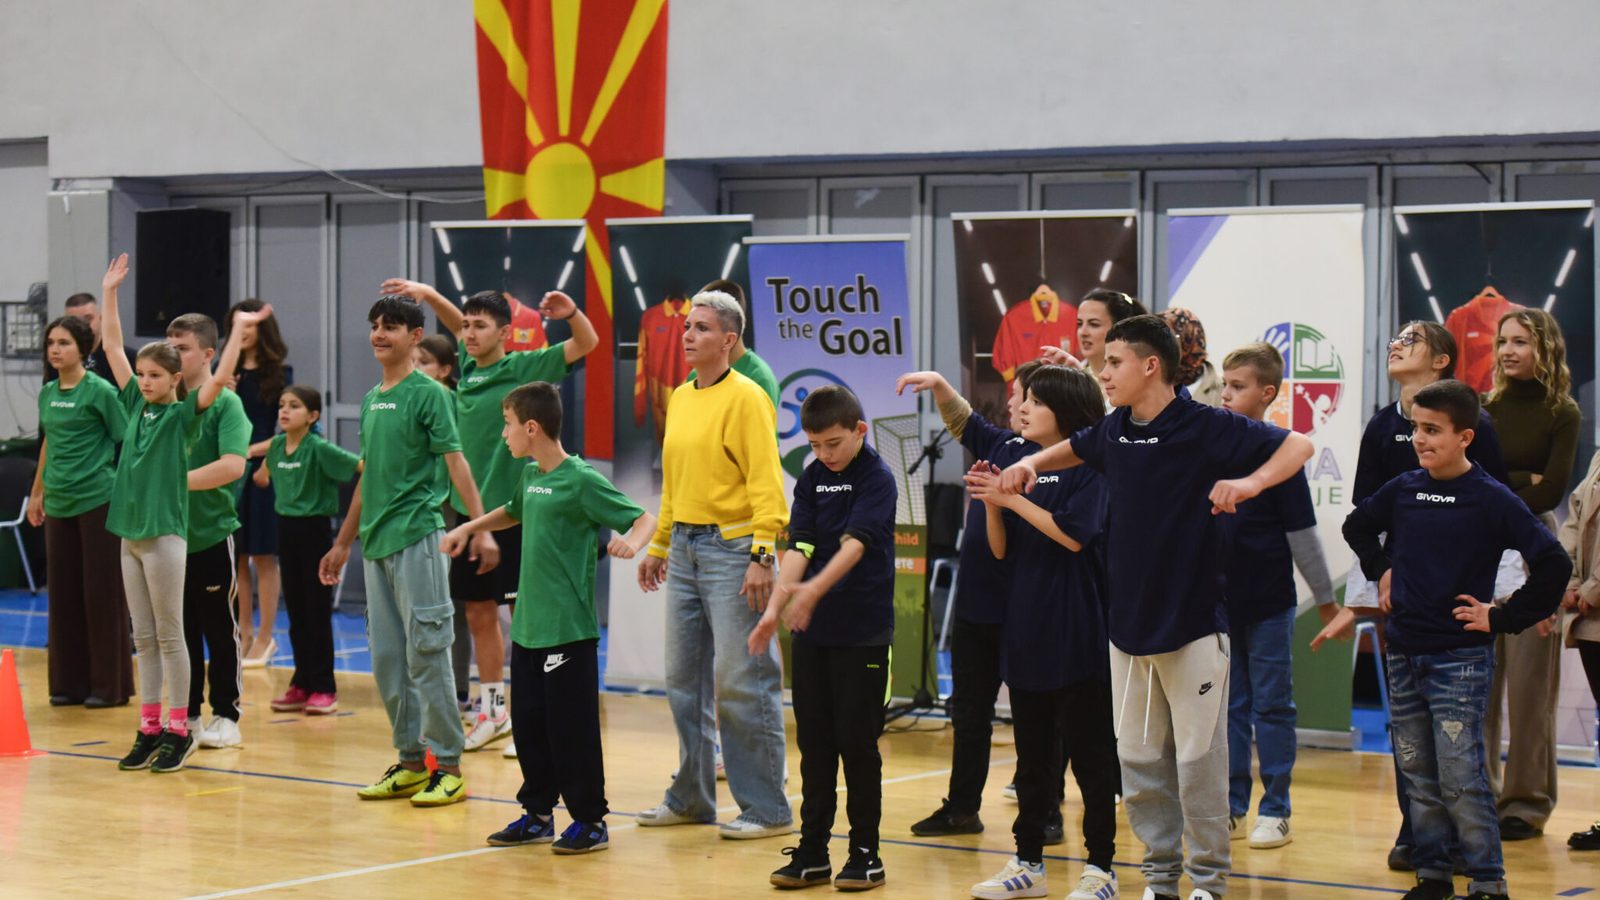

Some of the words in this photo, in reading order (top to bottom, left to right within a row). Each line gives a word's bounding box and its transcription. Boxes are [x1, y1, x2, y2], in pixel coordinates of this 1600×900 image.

[766, 274, 880, 314] Touch
[779, 318, 813, 340] the
[818, 317, 903, 356] Goal
[1395, 434, 1413, 442] GIV
[527, 486, 553, 495] GIVOVA
[816, 484, 853, 493] GIVOVA
[1416, 492, 1456, 504] GIVOVA
[895, 532, 919, 546] hild
[546, 653, 565, 665] NIKE
